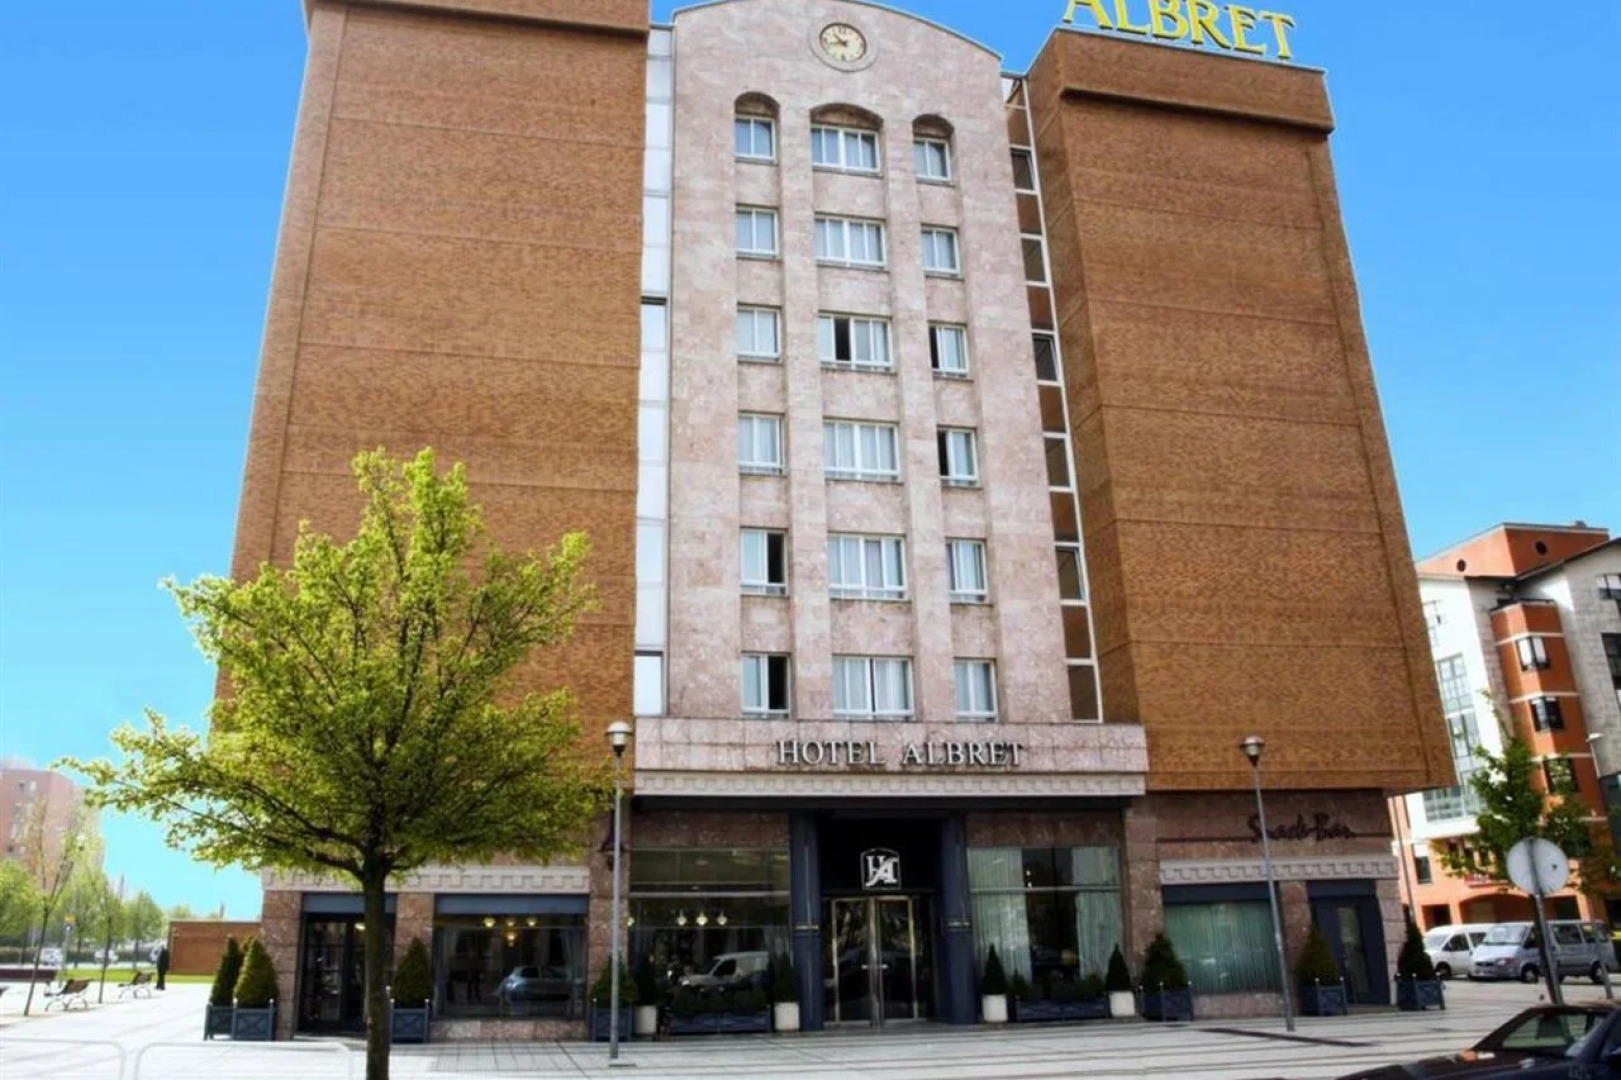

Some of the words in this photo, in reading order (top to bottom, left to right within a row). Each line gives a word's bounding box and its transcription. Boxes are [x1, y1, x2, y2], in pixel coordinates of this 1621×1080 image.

[1062, 0, 1296, 60] ALBRET
[777, 740, 886, 766] HOTEL
[902, 741, 1023, 767] ALBRET
